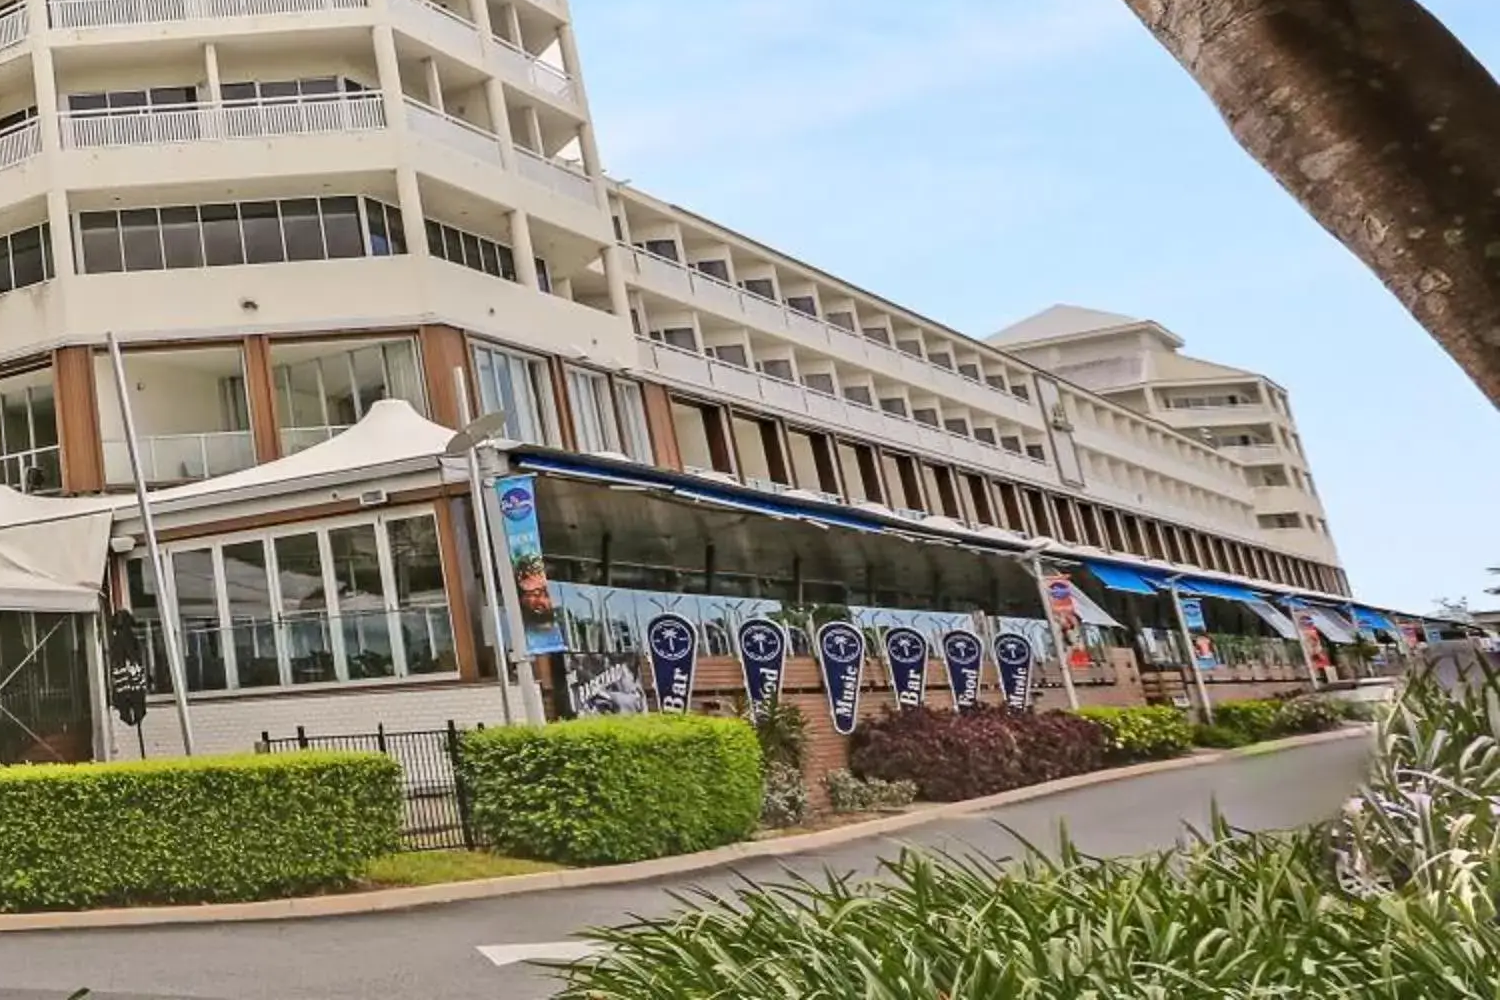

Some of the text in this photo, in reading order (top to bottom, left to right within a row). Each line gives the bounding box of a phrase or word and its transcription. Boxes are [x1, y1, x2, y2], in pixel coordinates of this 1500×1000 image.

[664, 668, 688, 711] Bar
[836, 665, 858, 717] Music
[900, 668, 920, 706] Bar
[958, 668, 977, 706] Food
[1010, 667, 1028, 709] Music
